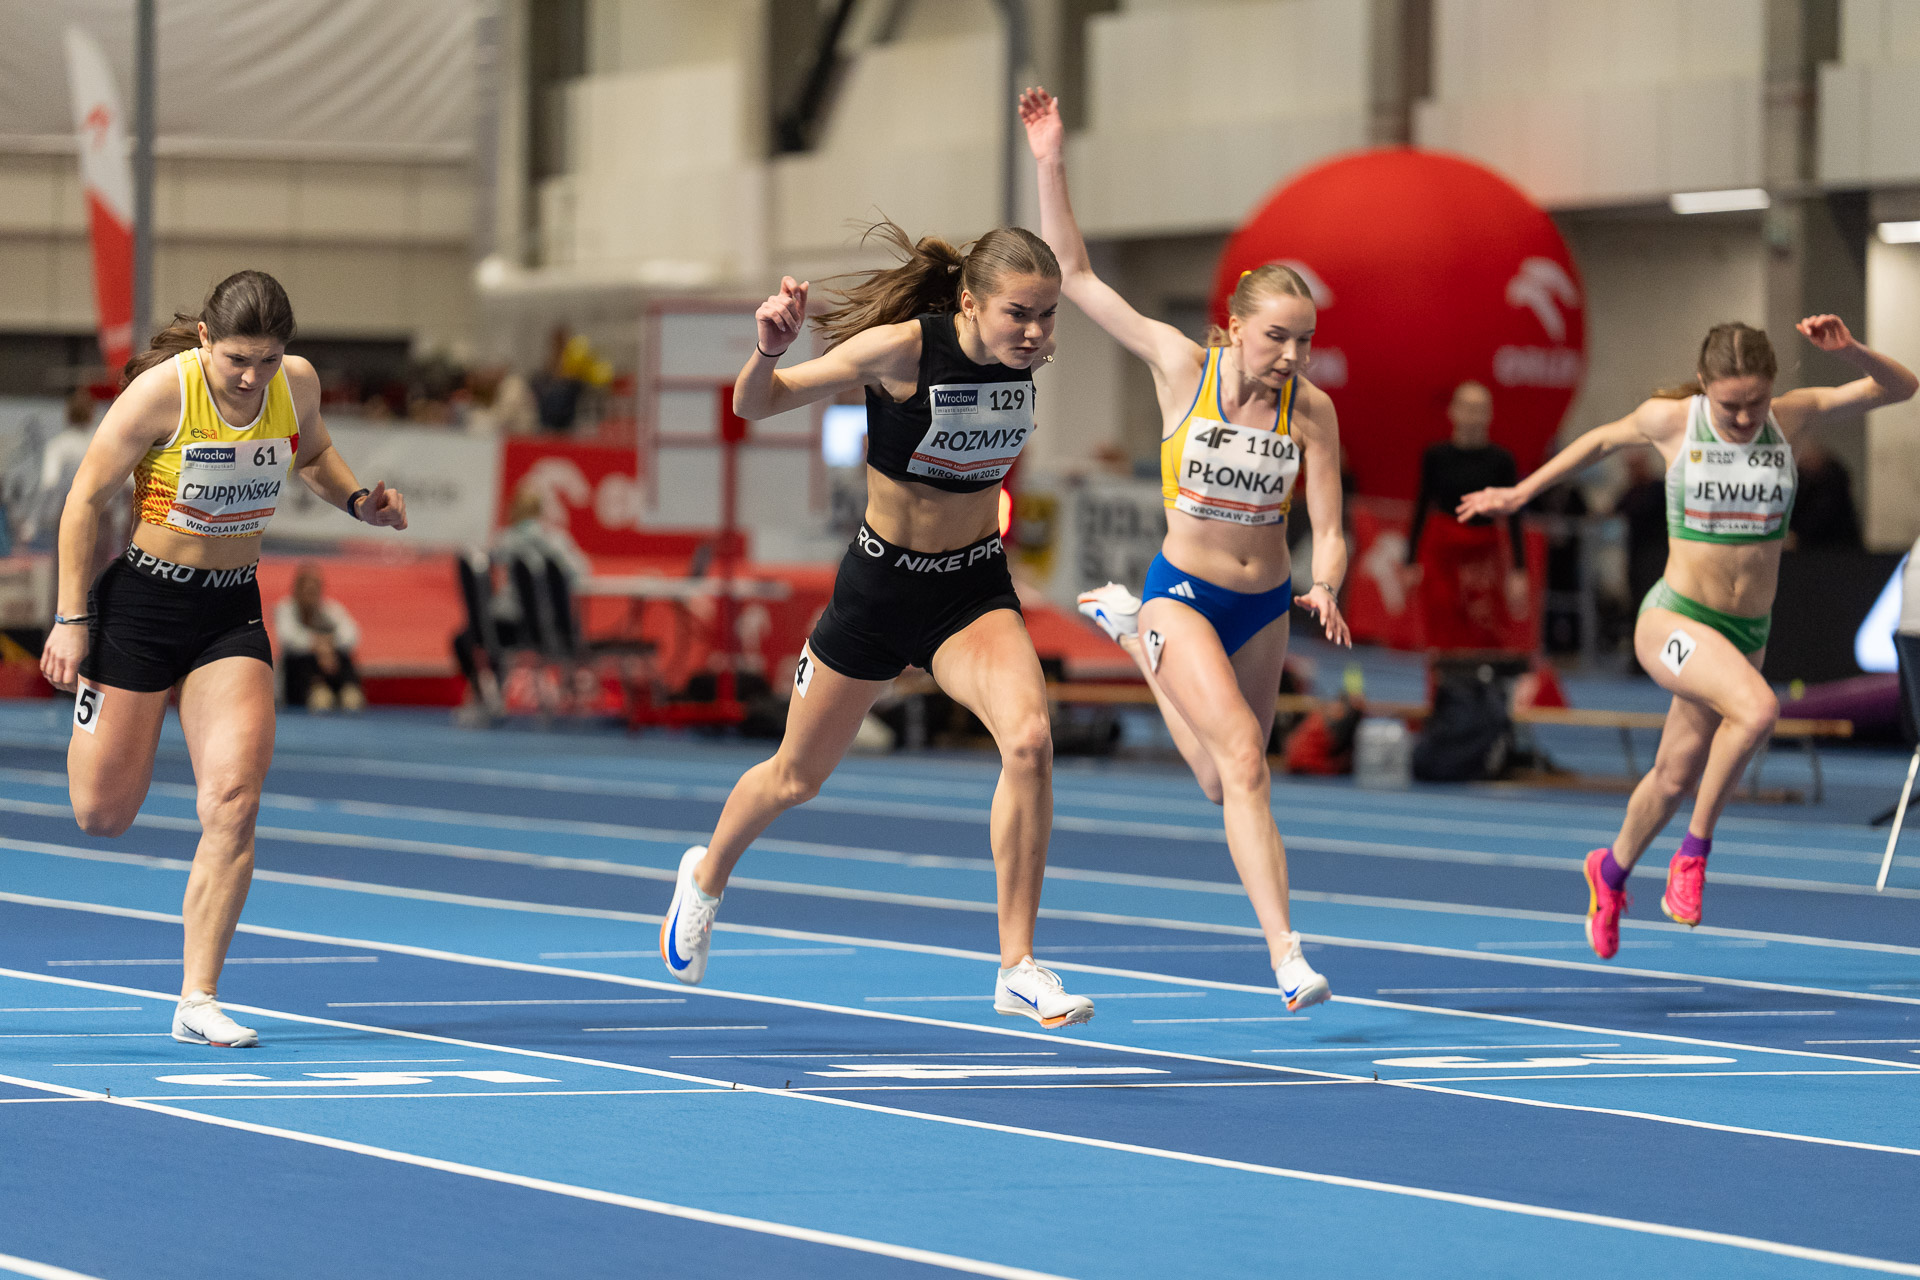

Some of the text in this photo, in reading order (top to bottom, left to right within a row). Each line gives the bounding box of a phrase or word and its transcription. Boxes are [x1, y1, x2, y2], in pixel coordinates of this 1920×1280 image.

[938, 393, 976, 404] Wrocław
[989, 389, 1025, 411] 129
[930, 428, 1027, 452] ROZMYS
[1195, 426, 1238, 449] 4F
[1246, 436, 1295, 460] 1101
[188, 448, 234, 460] Wrocław
[253, 446, 277, 467] 61
[1747, 450, 1785, 468] 628
[928, 466, 1000, 481] WROCŁAW 2025
[1187, 460, 1285, 494] PŁONKA
[183, 479, 281, 506] CZUPRYŃSKA
[1693, 481, 1784, 503] JEWUŁA
[1190, 504, 1244, 522] WROCŁAW
[186, 519, 259, 533] WROCŁAW 2025
[136, 552, 196, 583] PRO
[202, 561, 258, 589] NIKE
[894, 552, 965, 573] NIKE
[1667, 638, 1690, 666] 2
[796, 656, 809, 687] 4
[77, 688, 97, 725] 5
